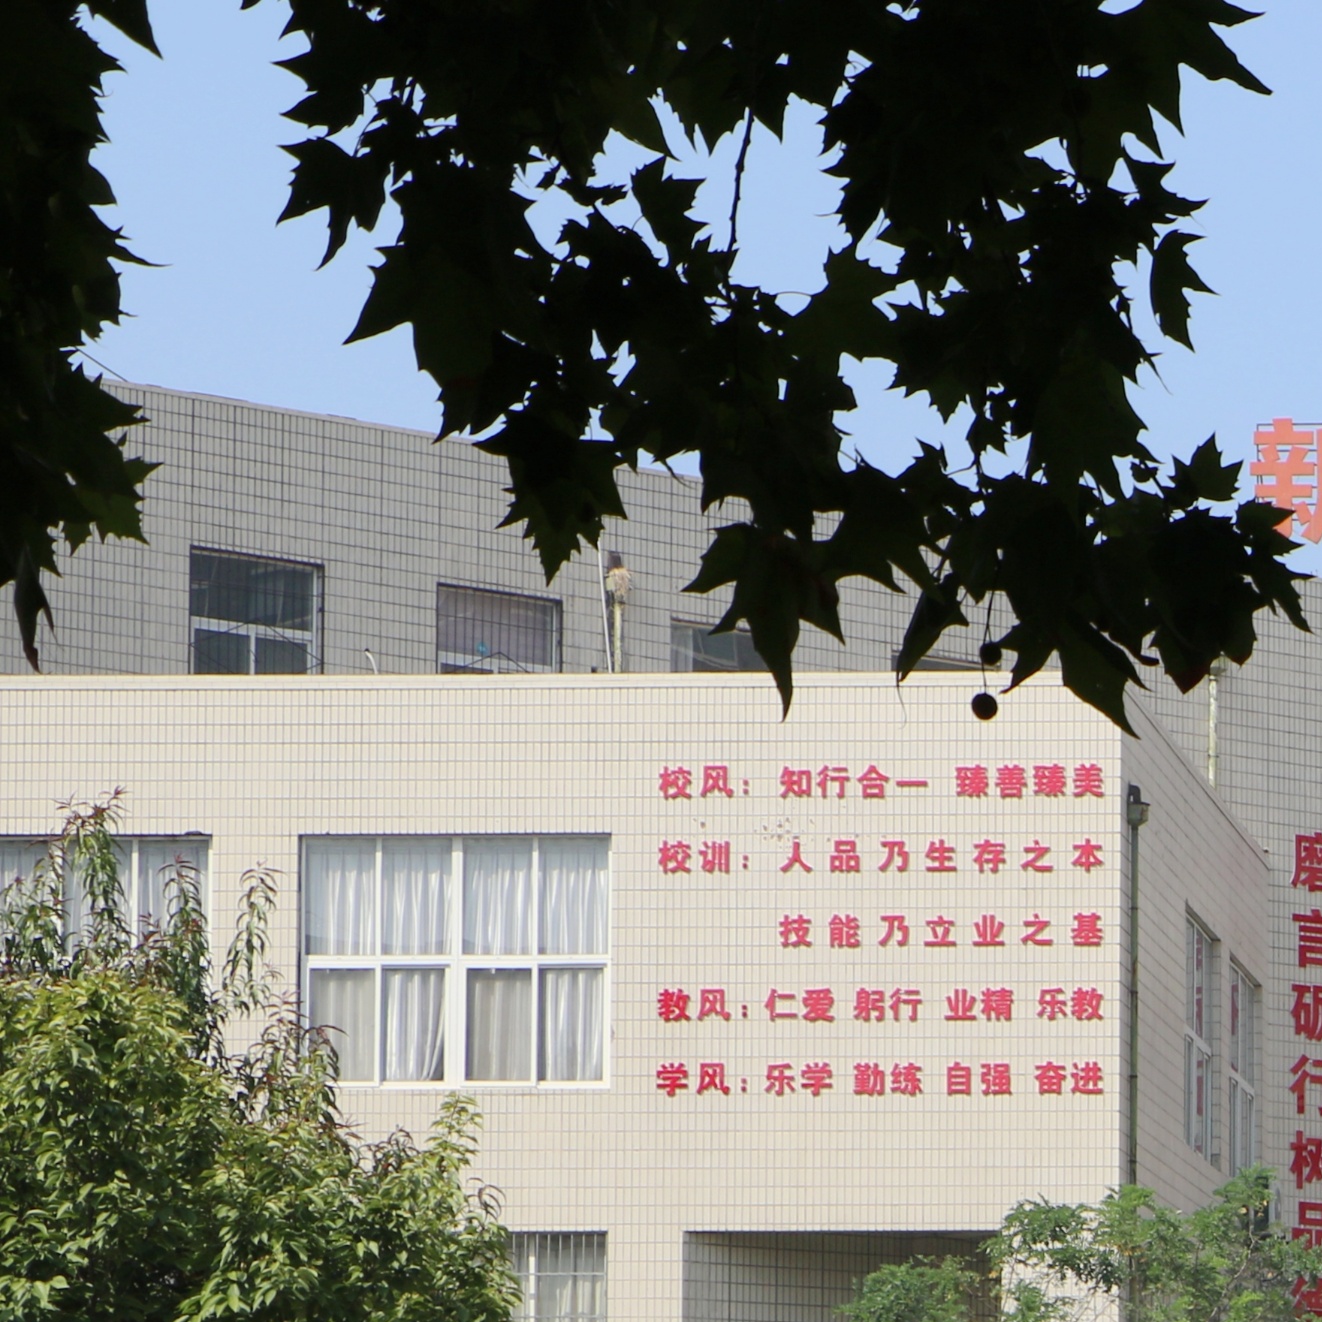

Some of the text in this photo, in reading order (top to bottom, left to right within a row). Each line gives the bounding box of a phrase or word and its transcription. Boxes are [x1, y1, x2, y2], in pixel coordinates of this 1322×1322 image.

[779, 914, 1103, 948] 技能乃立业之基
